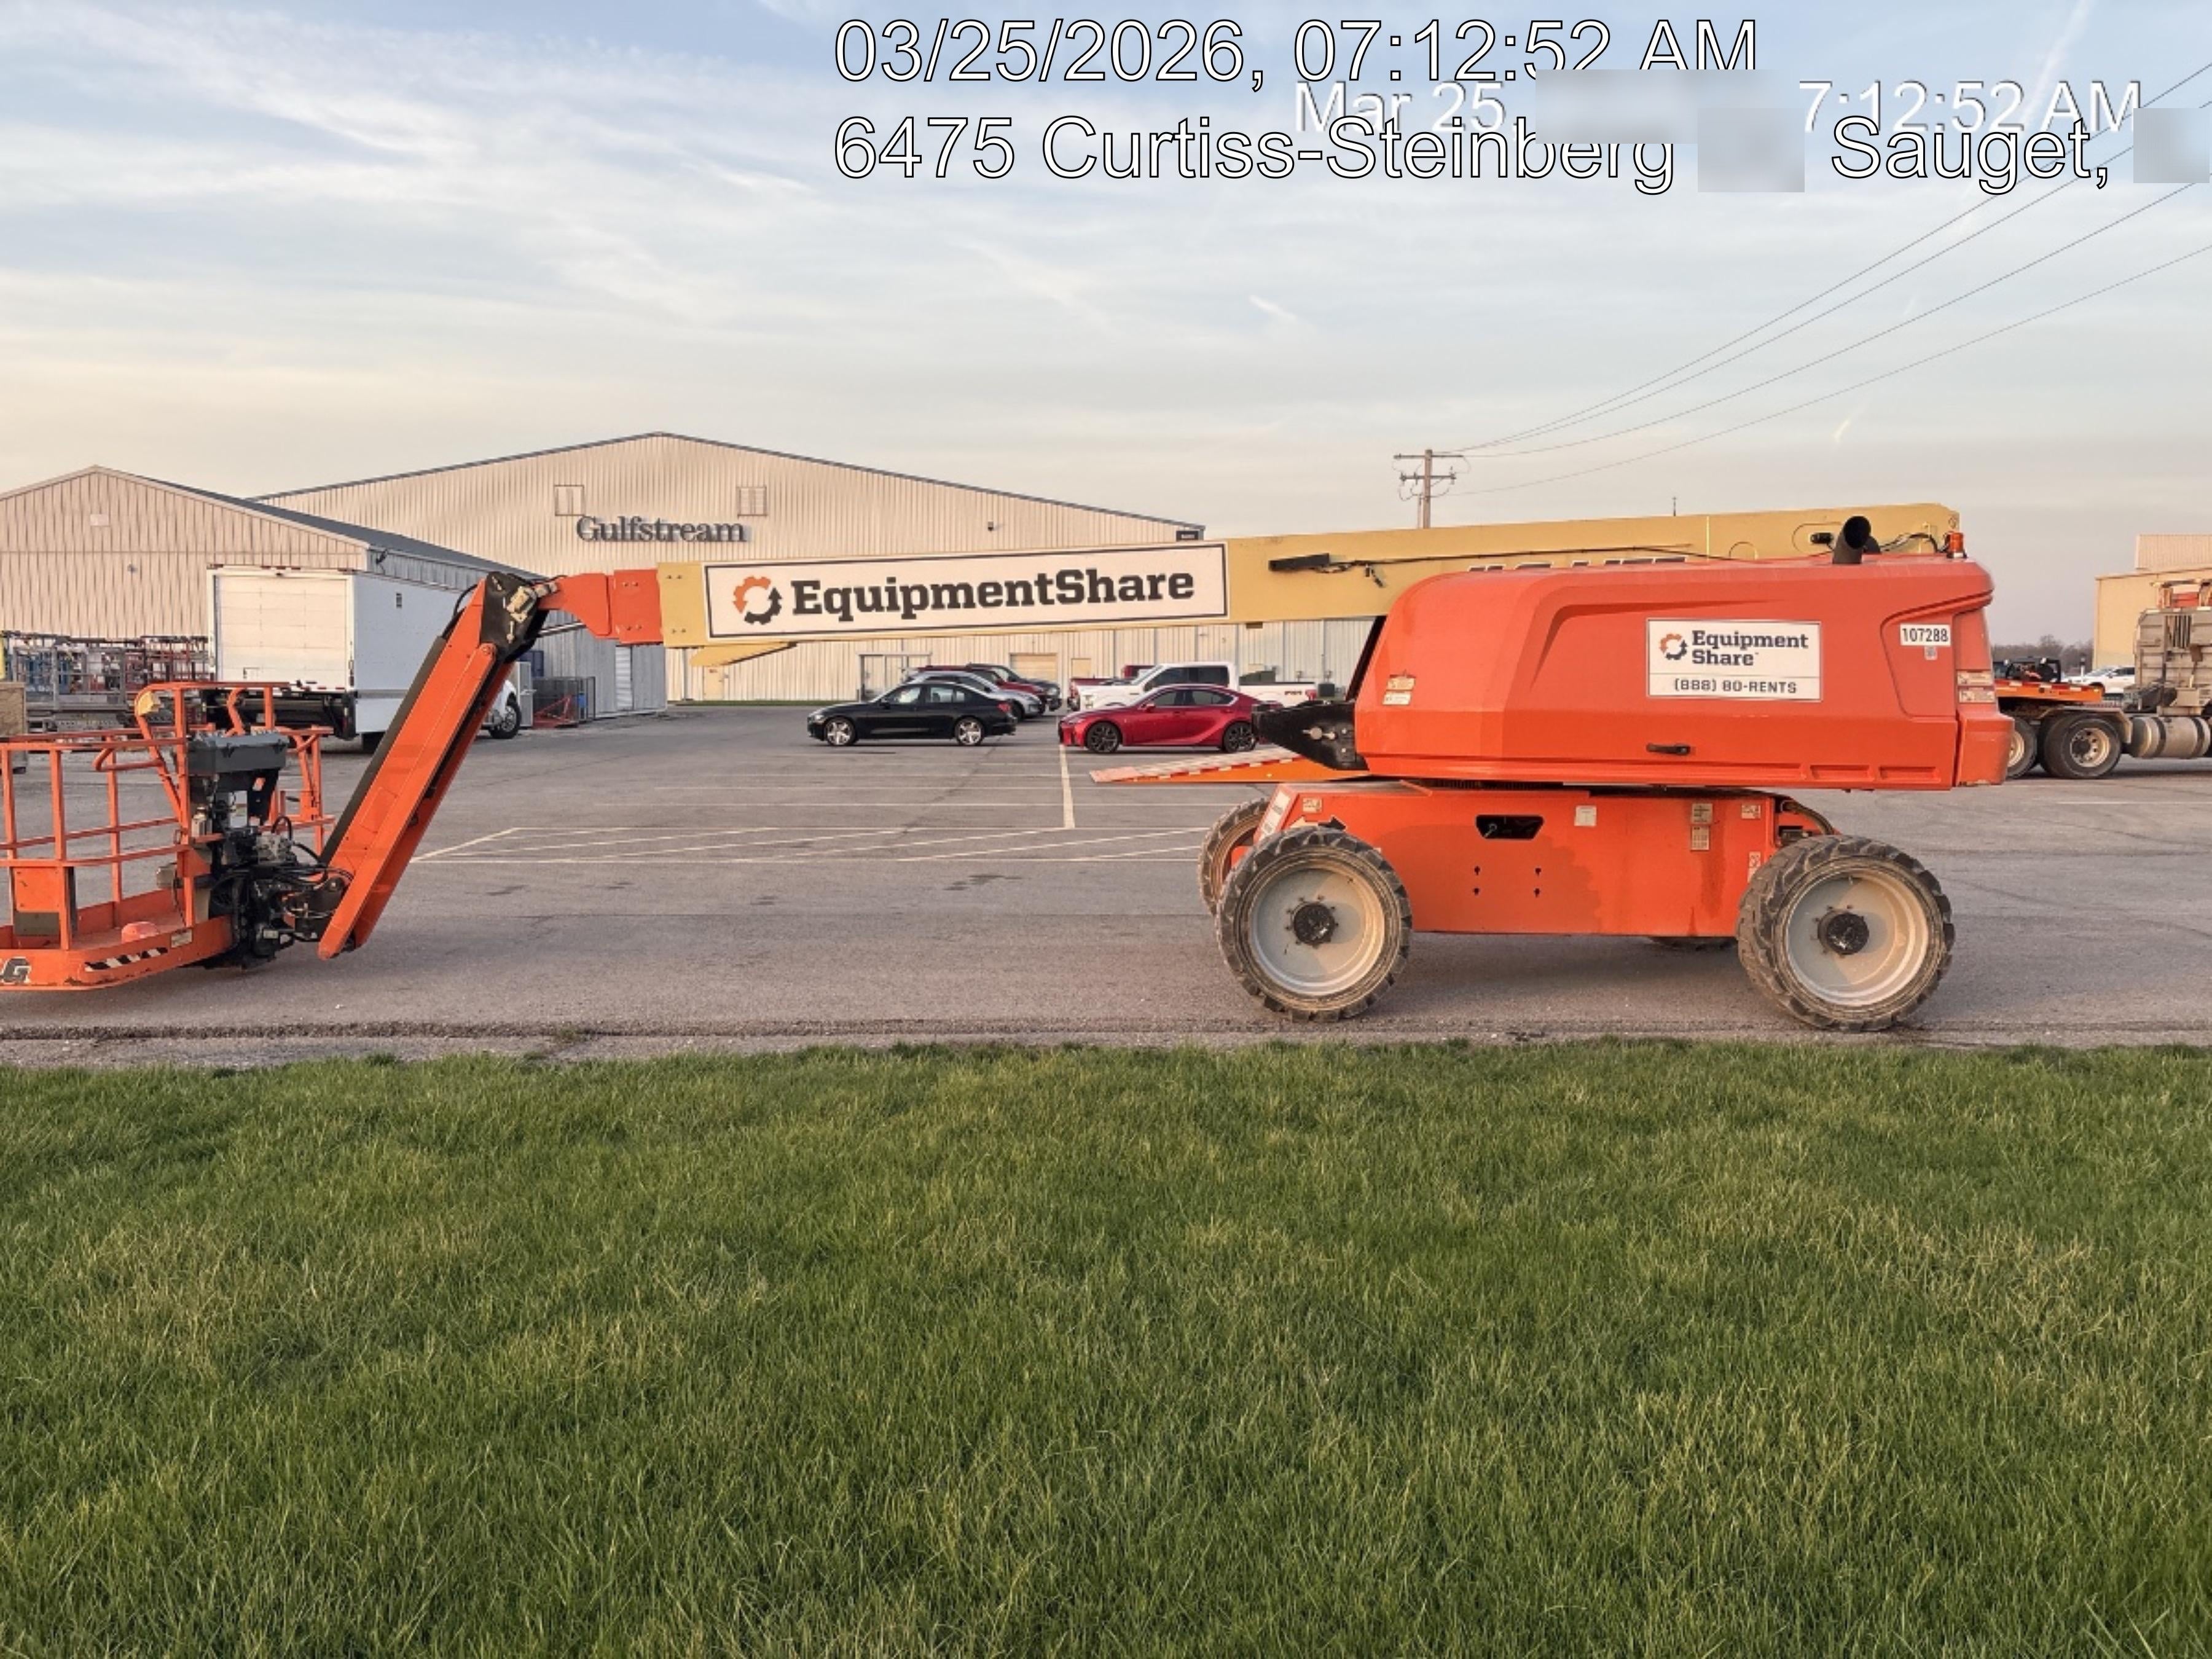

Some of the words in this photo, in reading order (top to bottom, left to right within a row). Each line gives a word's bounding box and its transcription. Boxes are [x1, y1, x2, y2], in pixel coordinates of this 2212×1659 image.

[576, 516, 747, 542] Gulfstream
[791, 569, 1194, 622] EquipmentShare
[1692, 630, 1809, 650] Equipment
[1902, 628, 1948, 642] 107288
[1692, 649, 1754, 666] Share
[1674, 678, 1717, 692] (888)
[1722, 680, 1797, 694] 80-RENTS
